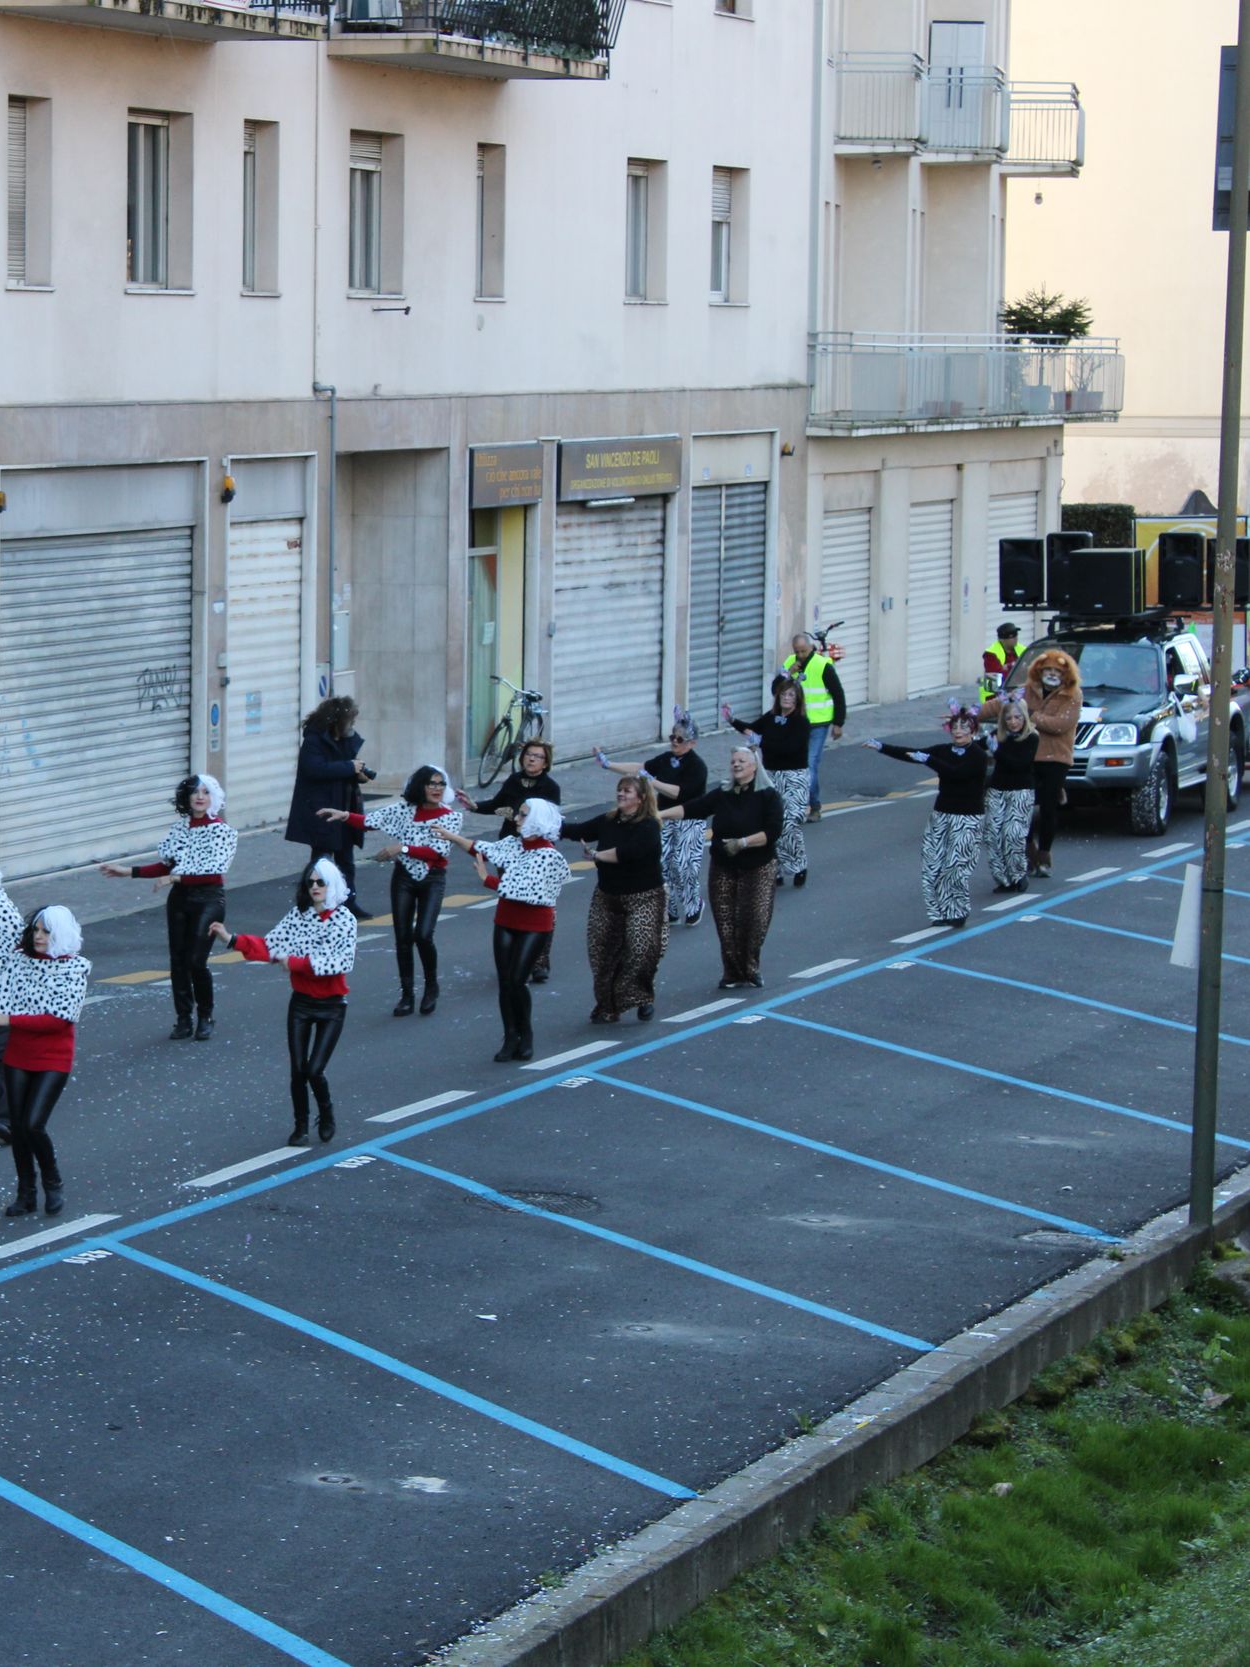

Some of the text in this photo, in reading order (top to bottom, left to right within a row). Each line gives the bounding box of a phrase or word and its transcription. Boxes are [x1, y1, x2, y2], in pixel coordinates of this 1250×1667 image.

[585, 449, 660, 469] SAN VINCENZO DE PAOLI
